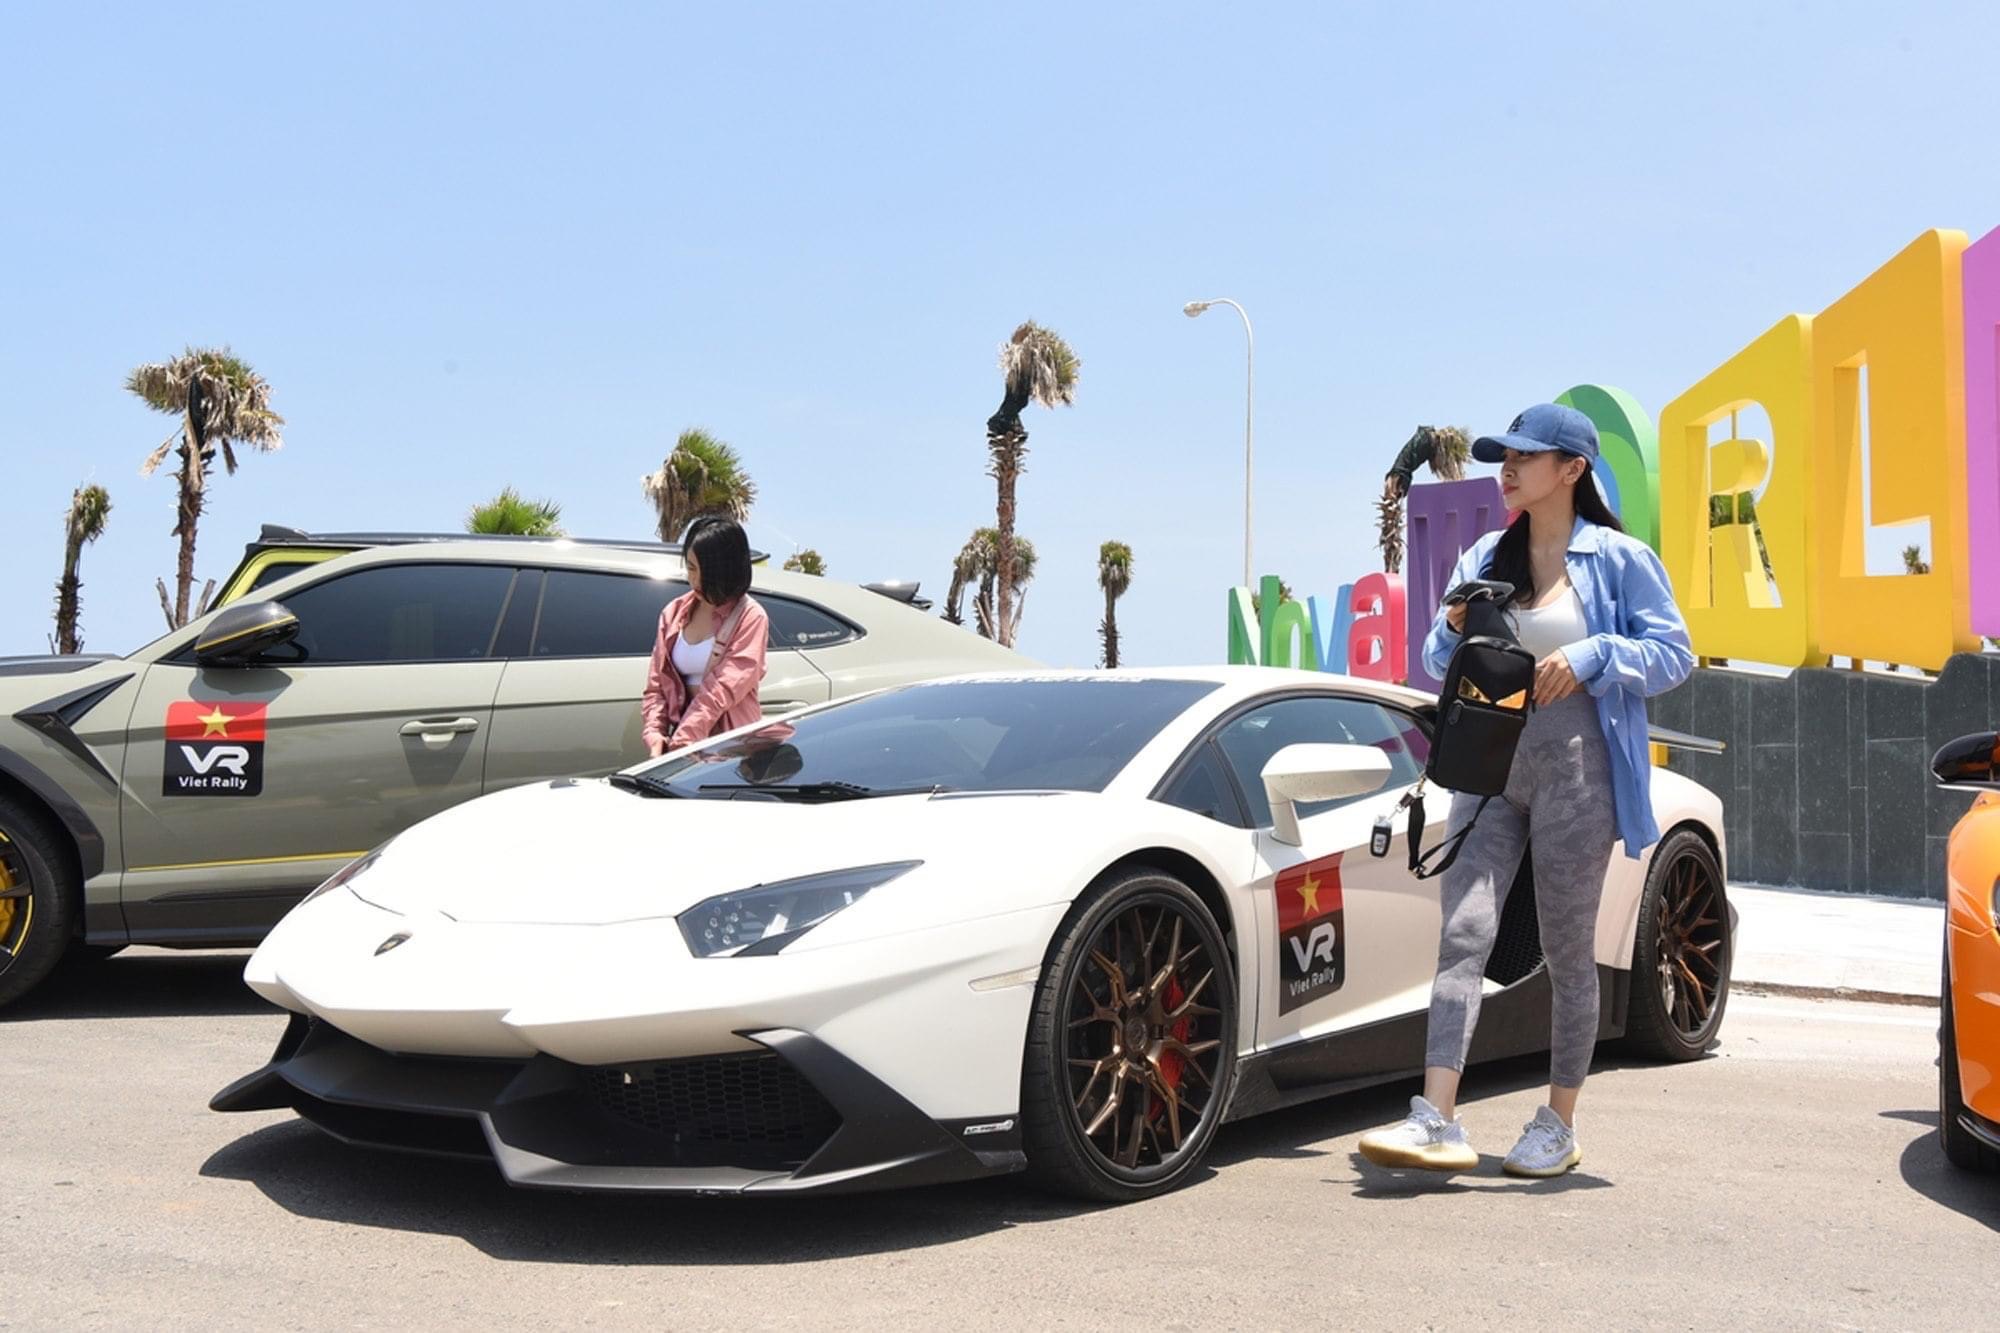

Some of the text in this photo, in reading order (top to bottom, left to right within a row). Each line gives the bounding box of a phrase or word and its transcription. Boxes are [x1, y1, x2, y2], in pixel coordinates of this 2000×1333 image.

[1407, 226, 2000, 692] WRL
[180, 745, 250, 775] VR
[178, 776, 248, 791] Viet Rally
[1289, 922, 1336, 973] VR
[1289, 967, 1336, 997] Viet Rally
